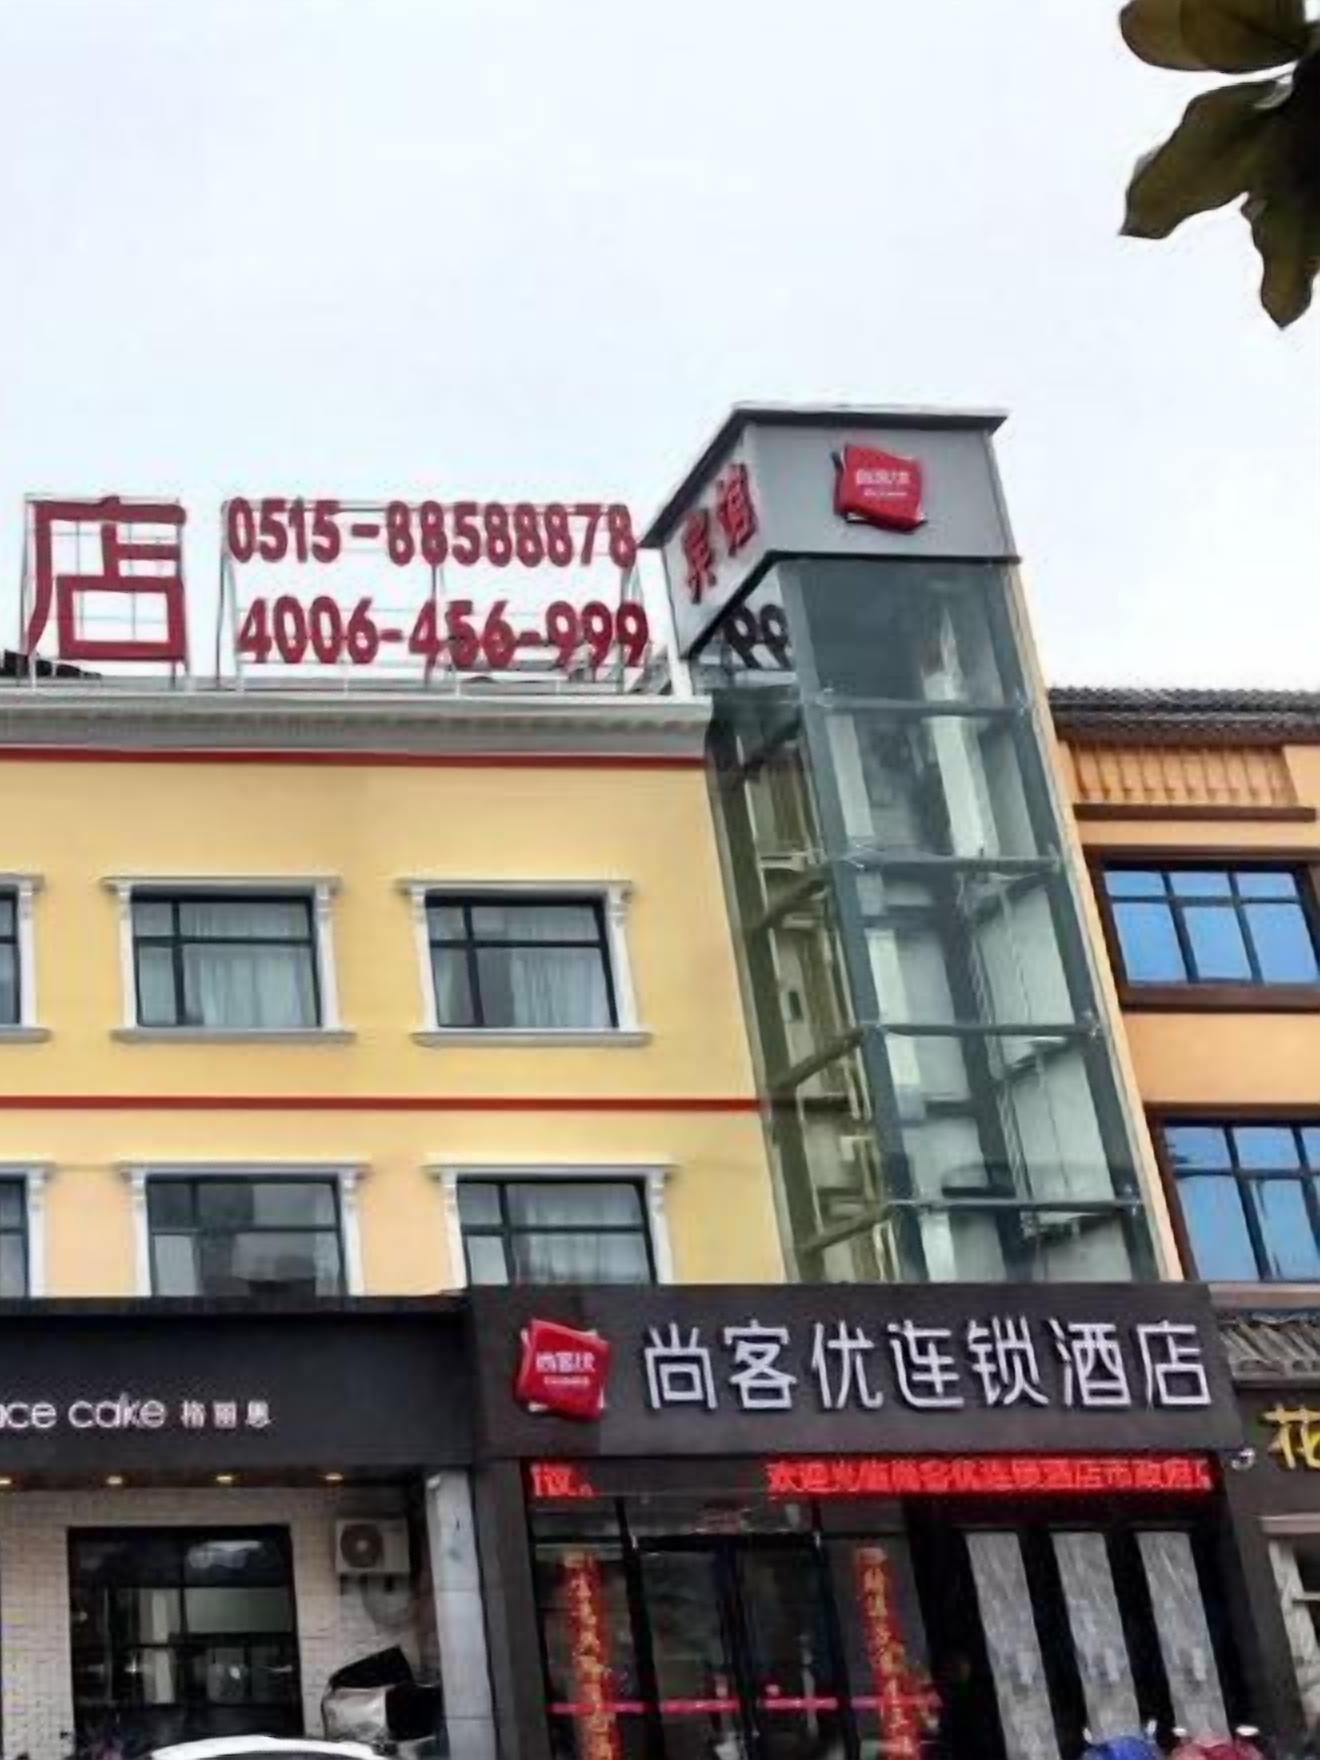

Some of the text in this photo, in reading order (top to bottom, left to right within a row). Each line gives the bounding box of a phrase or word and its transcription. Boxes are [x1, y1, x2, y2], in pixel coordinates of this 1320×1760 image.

[227, 496, 637, 568] 0515-88588878
[237, 596, 650, 668] 4006-456-999
[643, 1315, 1214, 1411] 尚客优连锁酒店
[67, 1392, 166, 1428] cake
[1263, 1402, 1320, 1470] 花
